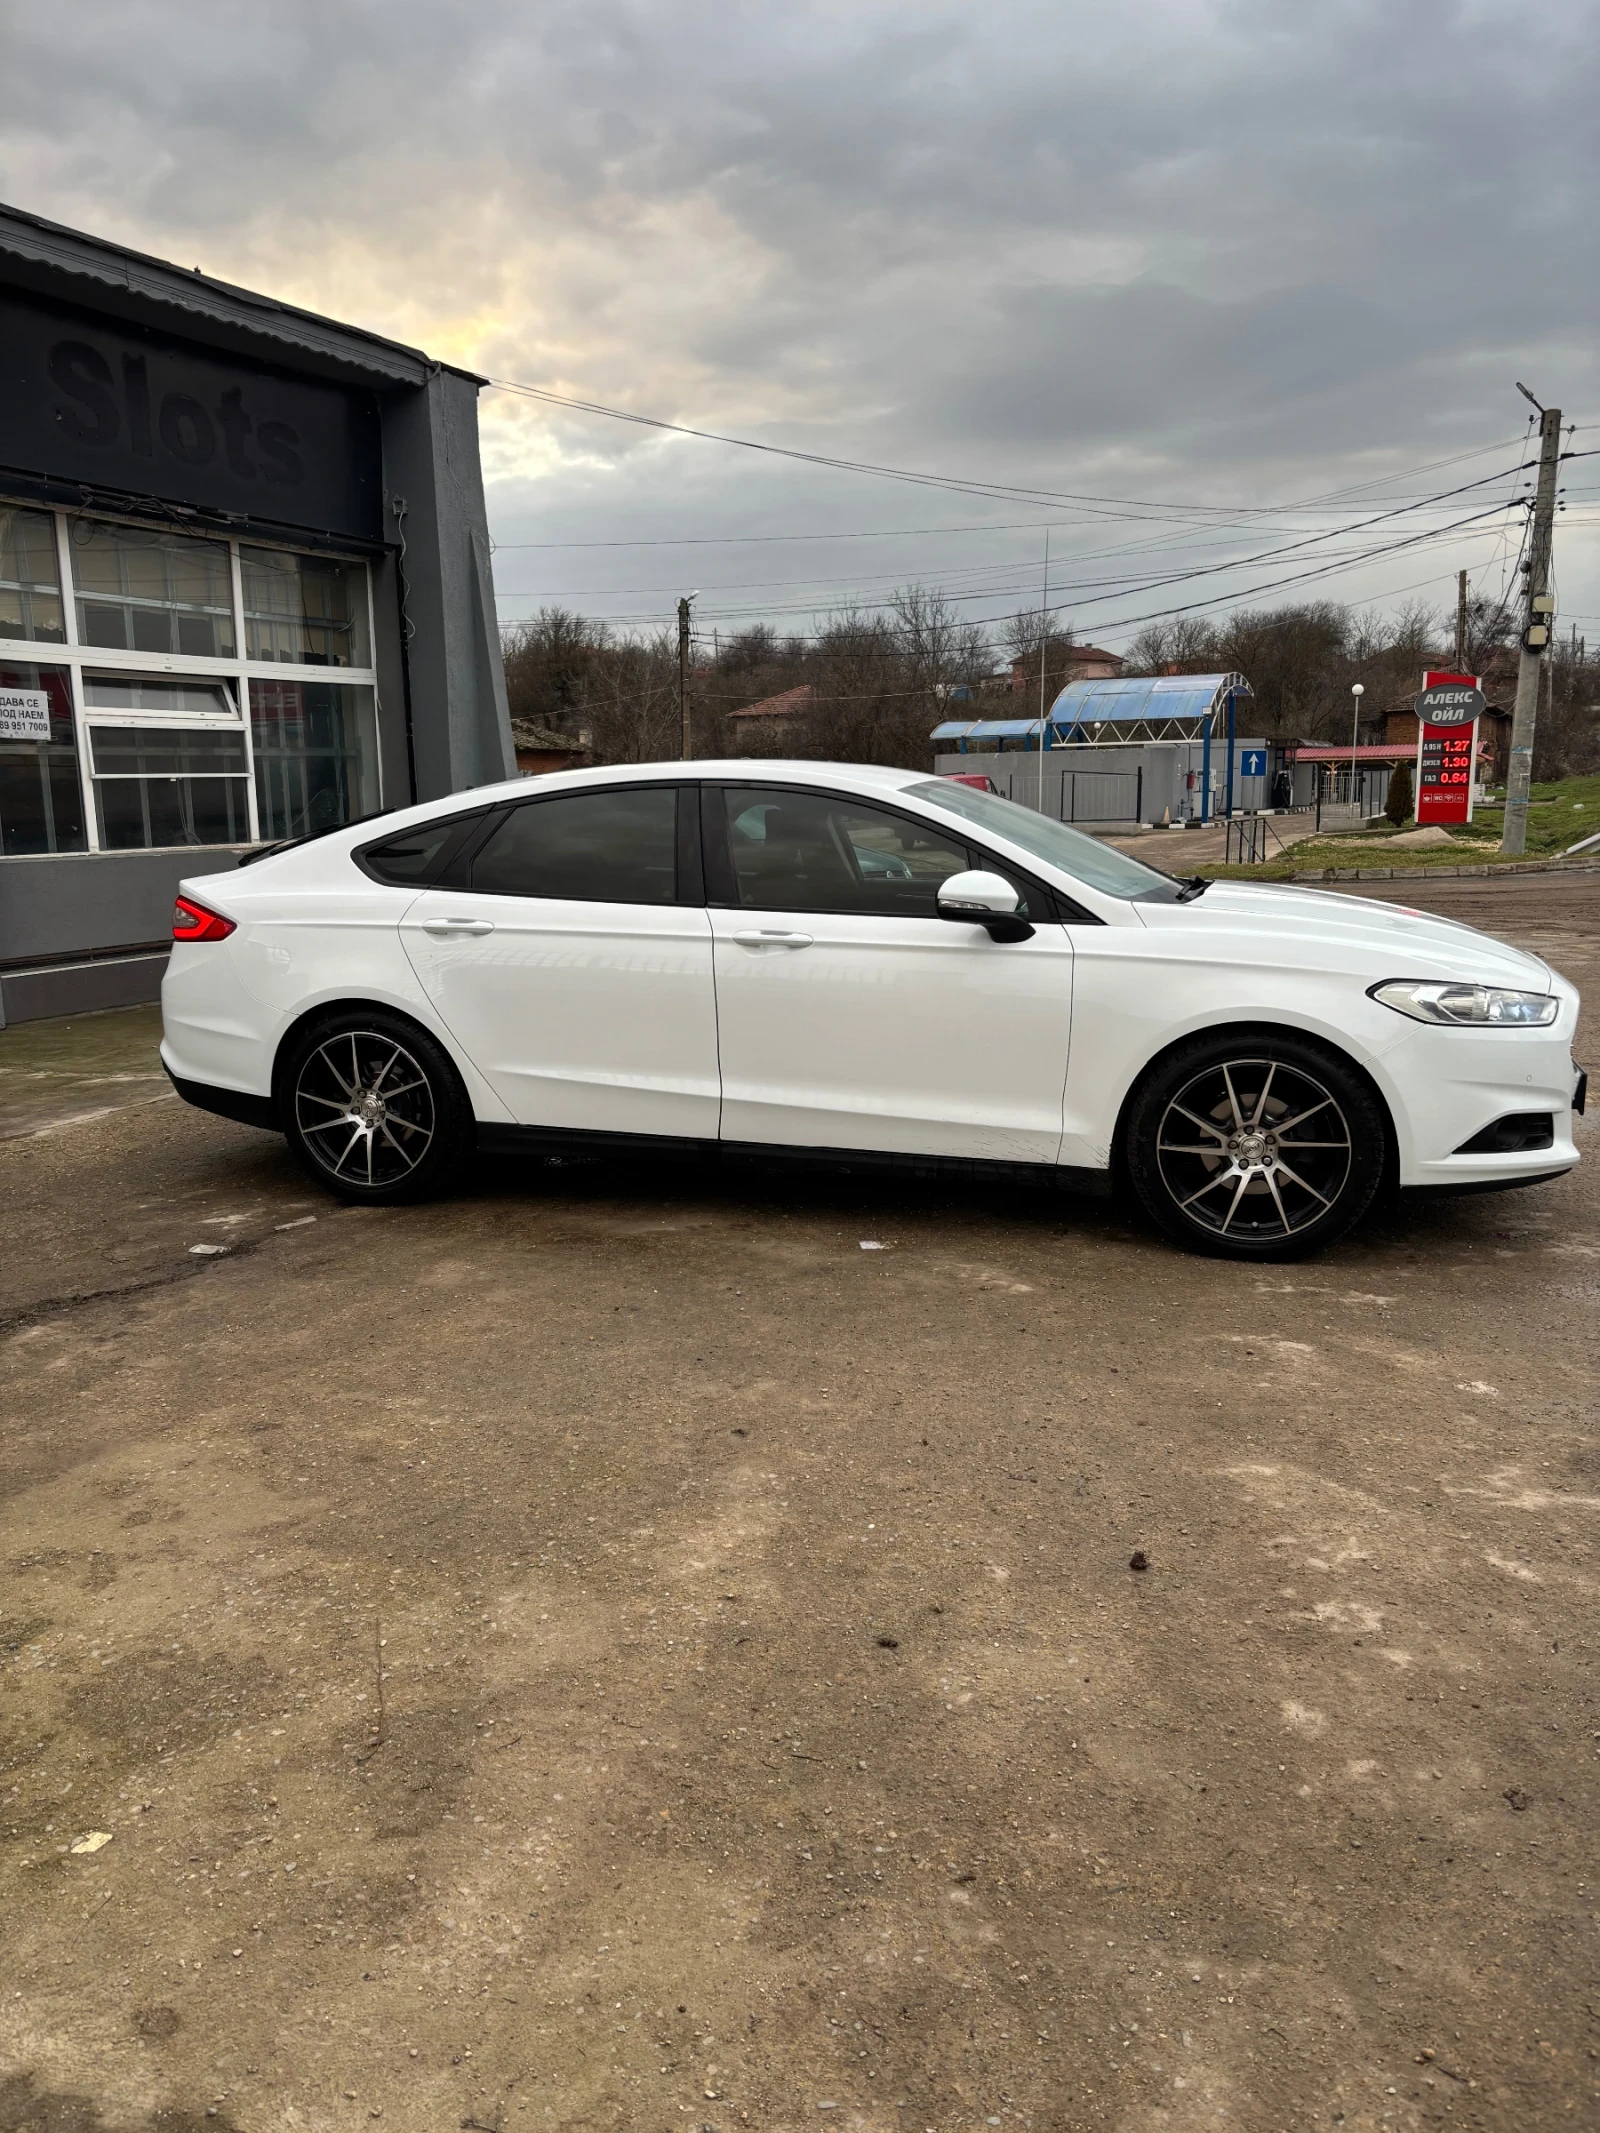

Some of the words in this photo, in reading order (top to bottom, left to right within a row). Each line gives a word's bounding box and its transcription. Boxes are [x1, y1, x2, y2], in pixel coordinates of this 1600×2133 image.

[49, 340, 305, 487] Slots
[26, 699, 39, 708] СЕ
[1423, 691, 1474, 705] АЛЕКС
[18, 710, 44, 719] НАЕМ
[1431, 706, 1465, 722] ОЙЛ
[11, 721, 26, 730] 951
[28, 722, 48, 731] 7009
[1443, 740, 1470, 752] 1.27
[1442, 757, 1469, 768] 1.30
[1440, 772, 1467, 784] 0.64
